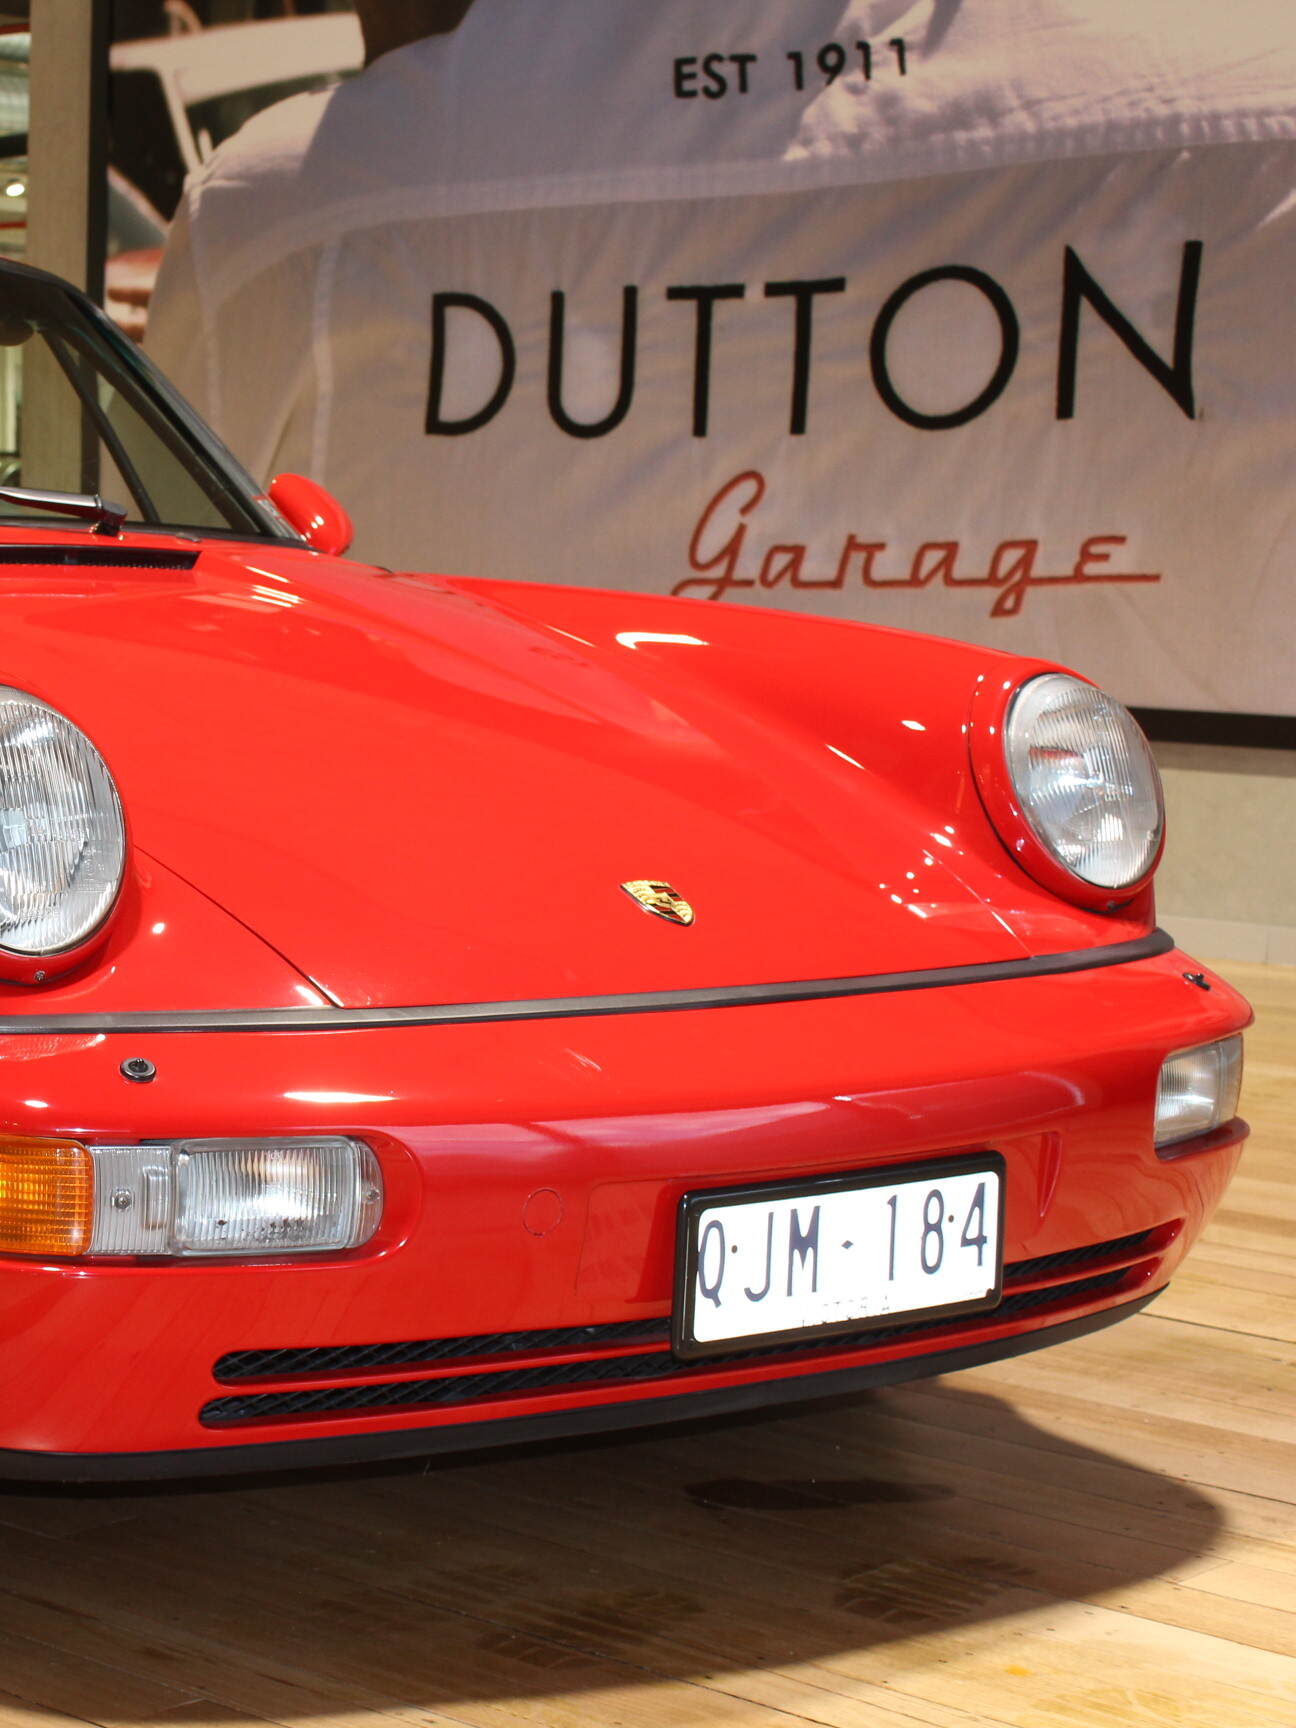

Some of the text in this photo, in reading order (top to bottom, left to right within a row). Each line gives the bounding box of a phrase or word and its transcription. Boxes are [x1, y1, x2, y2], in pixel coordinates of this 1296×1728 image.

[674, 38, 907, 99] EST 1911
[425, 240, 1203, 439] DUTTON
[672, 470, 1161, 618] Garage
